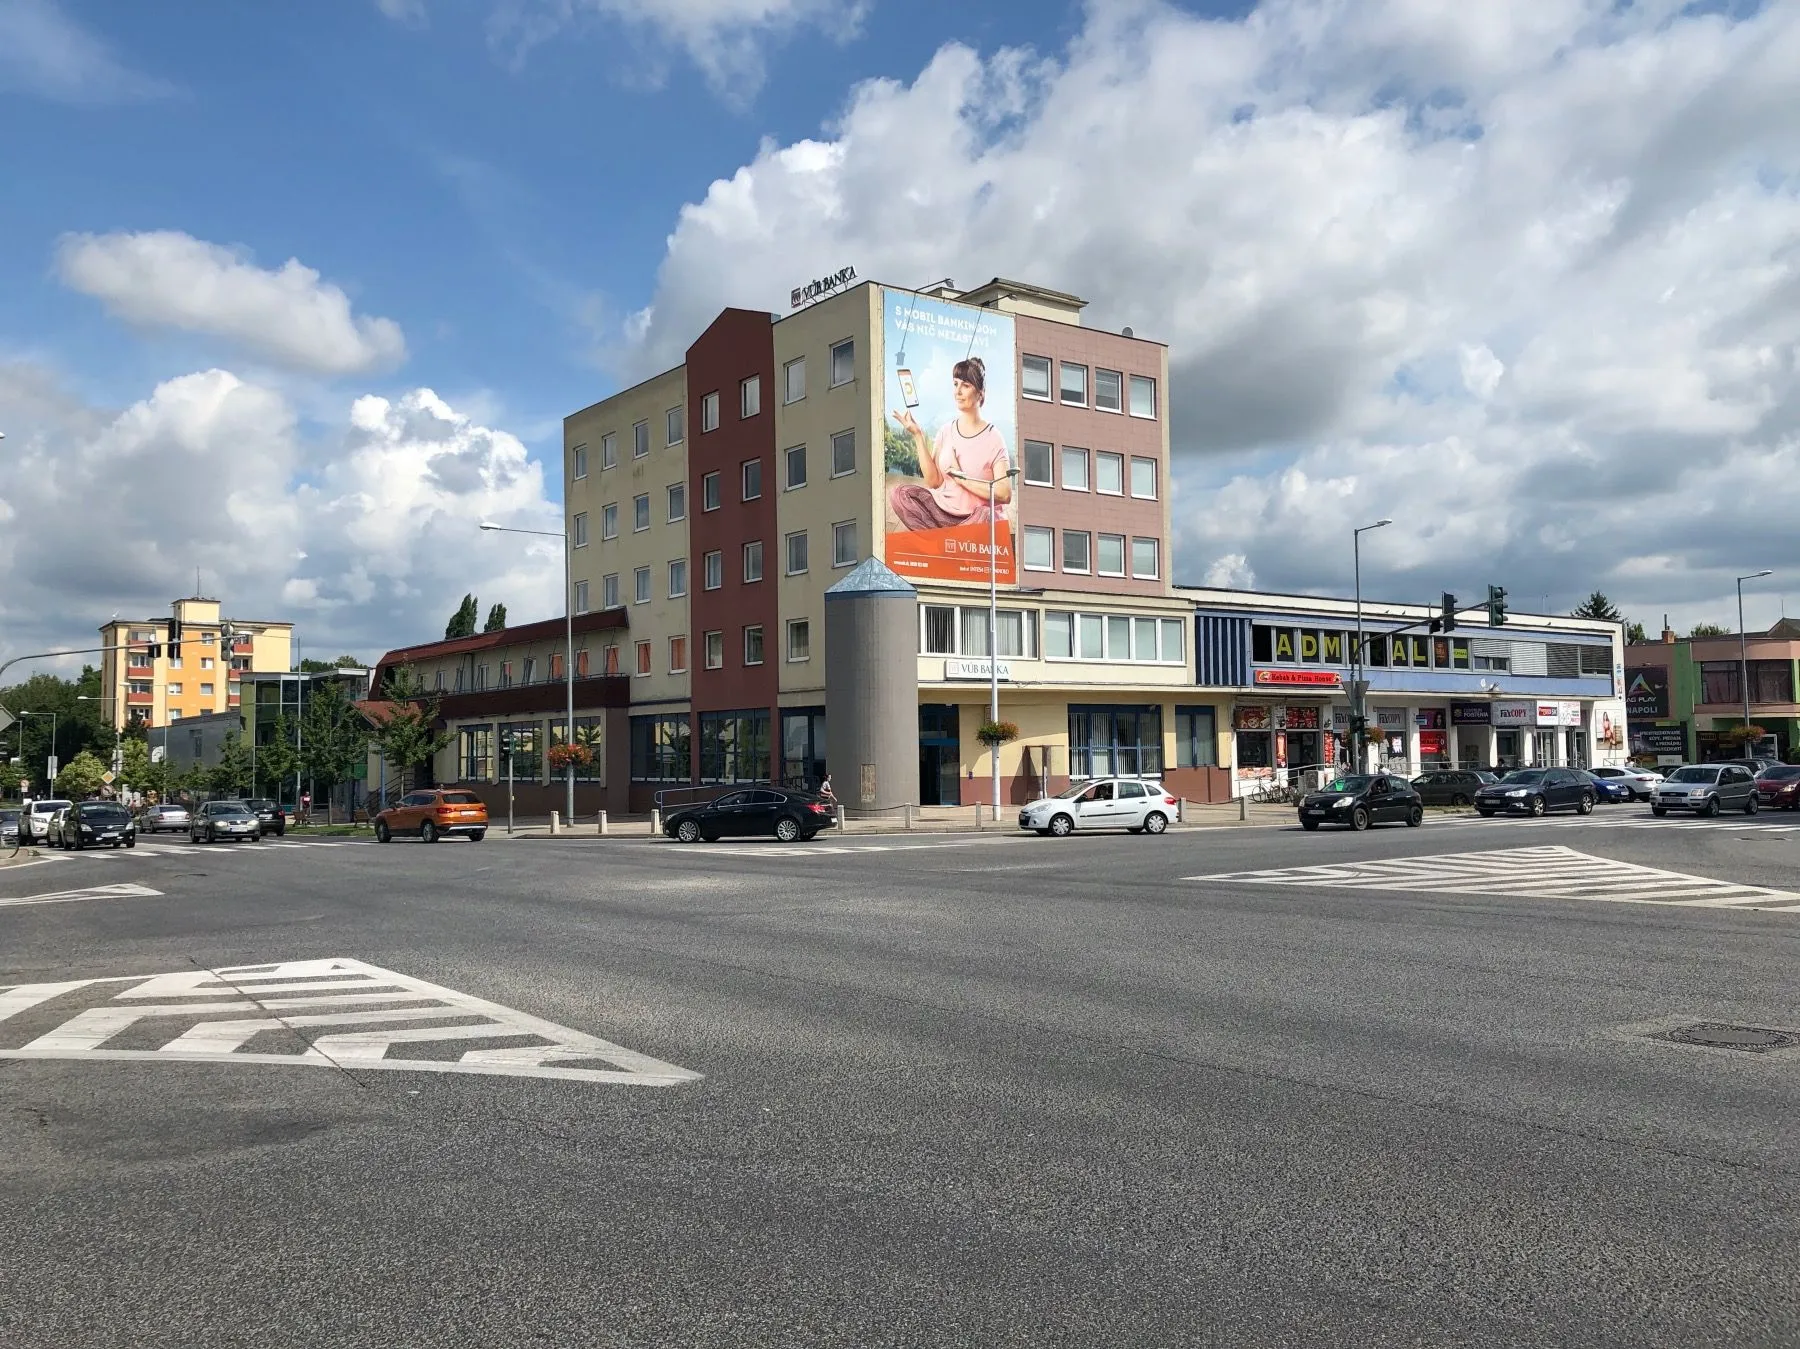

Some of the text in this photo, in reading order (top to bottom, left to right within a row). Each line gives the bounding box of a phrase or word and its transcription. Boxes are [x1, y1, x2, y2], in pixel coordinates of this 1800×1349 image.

[802, 265, 858, 301] VÚB BANKA
[895, 305, 902, 316] S
[903, 309, 936, 324] MOBIL
[895, 319, 914, 333] VÁS
[958, 540, 977, 553] VÚB
[1276, 633, 1427, 662] ADMIAL
[961, 661, 979, 674] VÚB
[1271, 674, 1290, 682] Kebab
[1297, 674, 1312, 682] Pizza
[1314, 675, 1332, 683] House
[1626, 706, 1658, 714] NAPOLI
